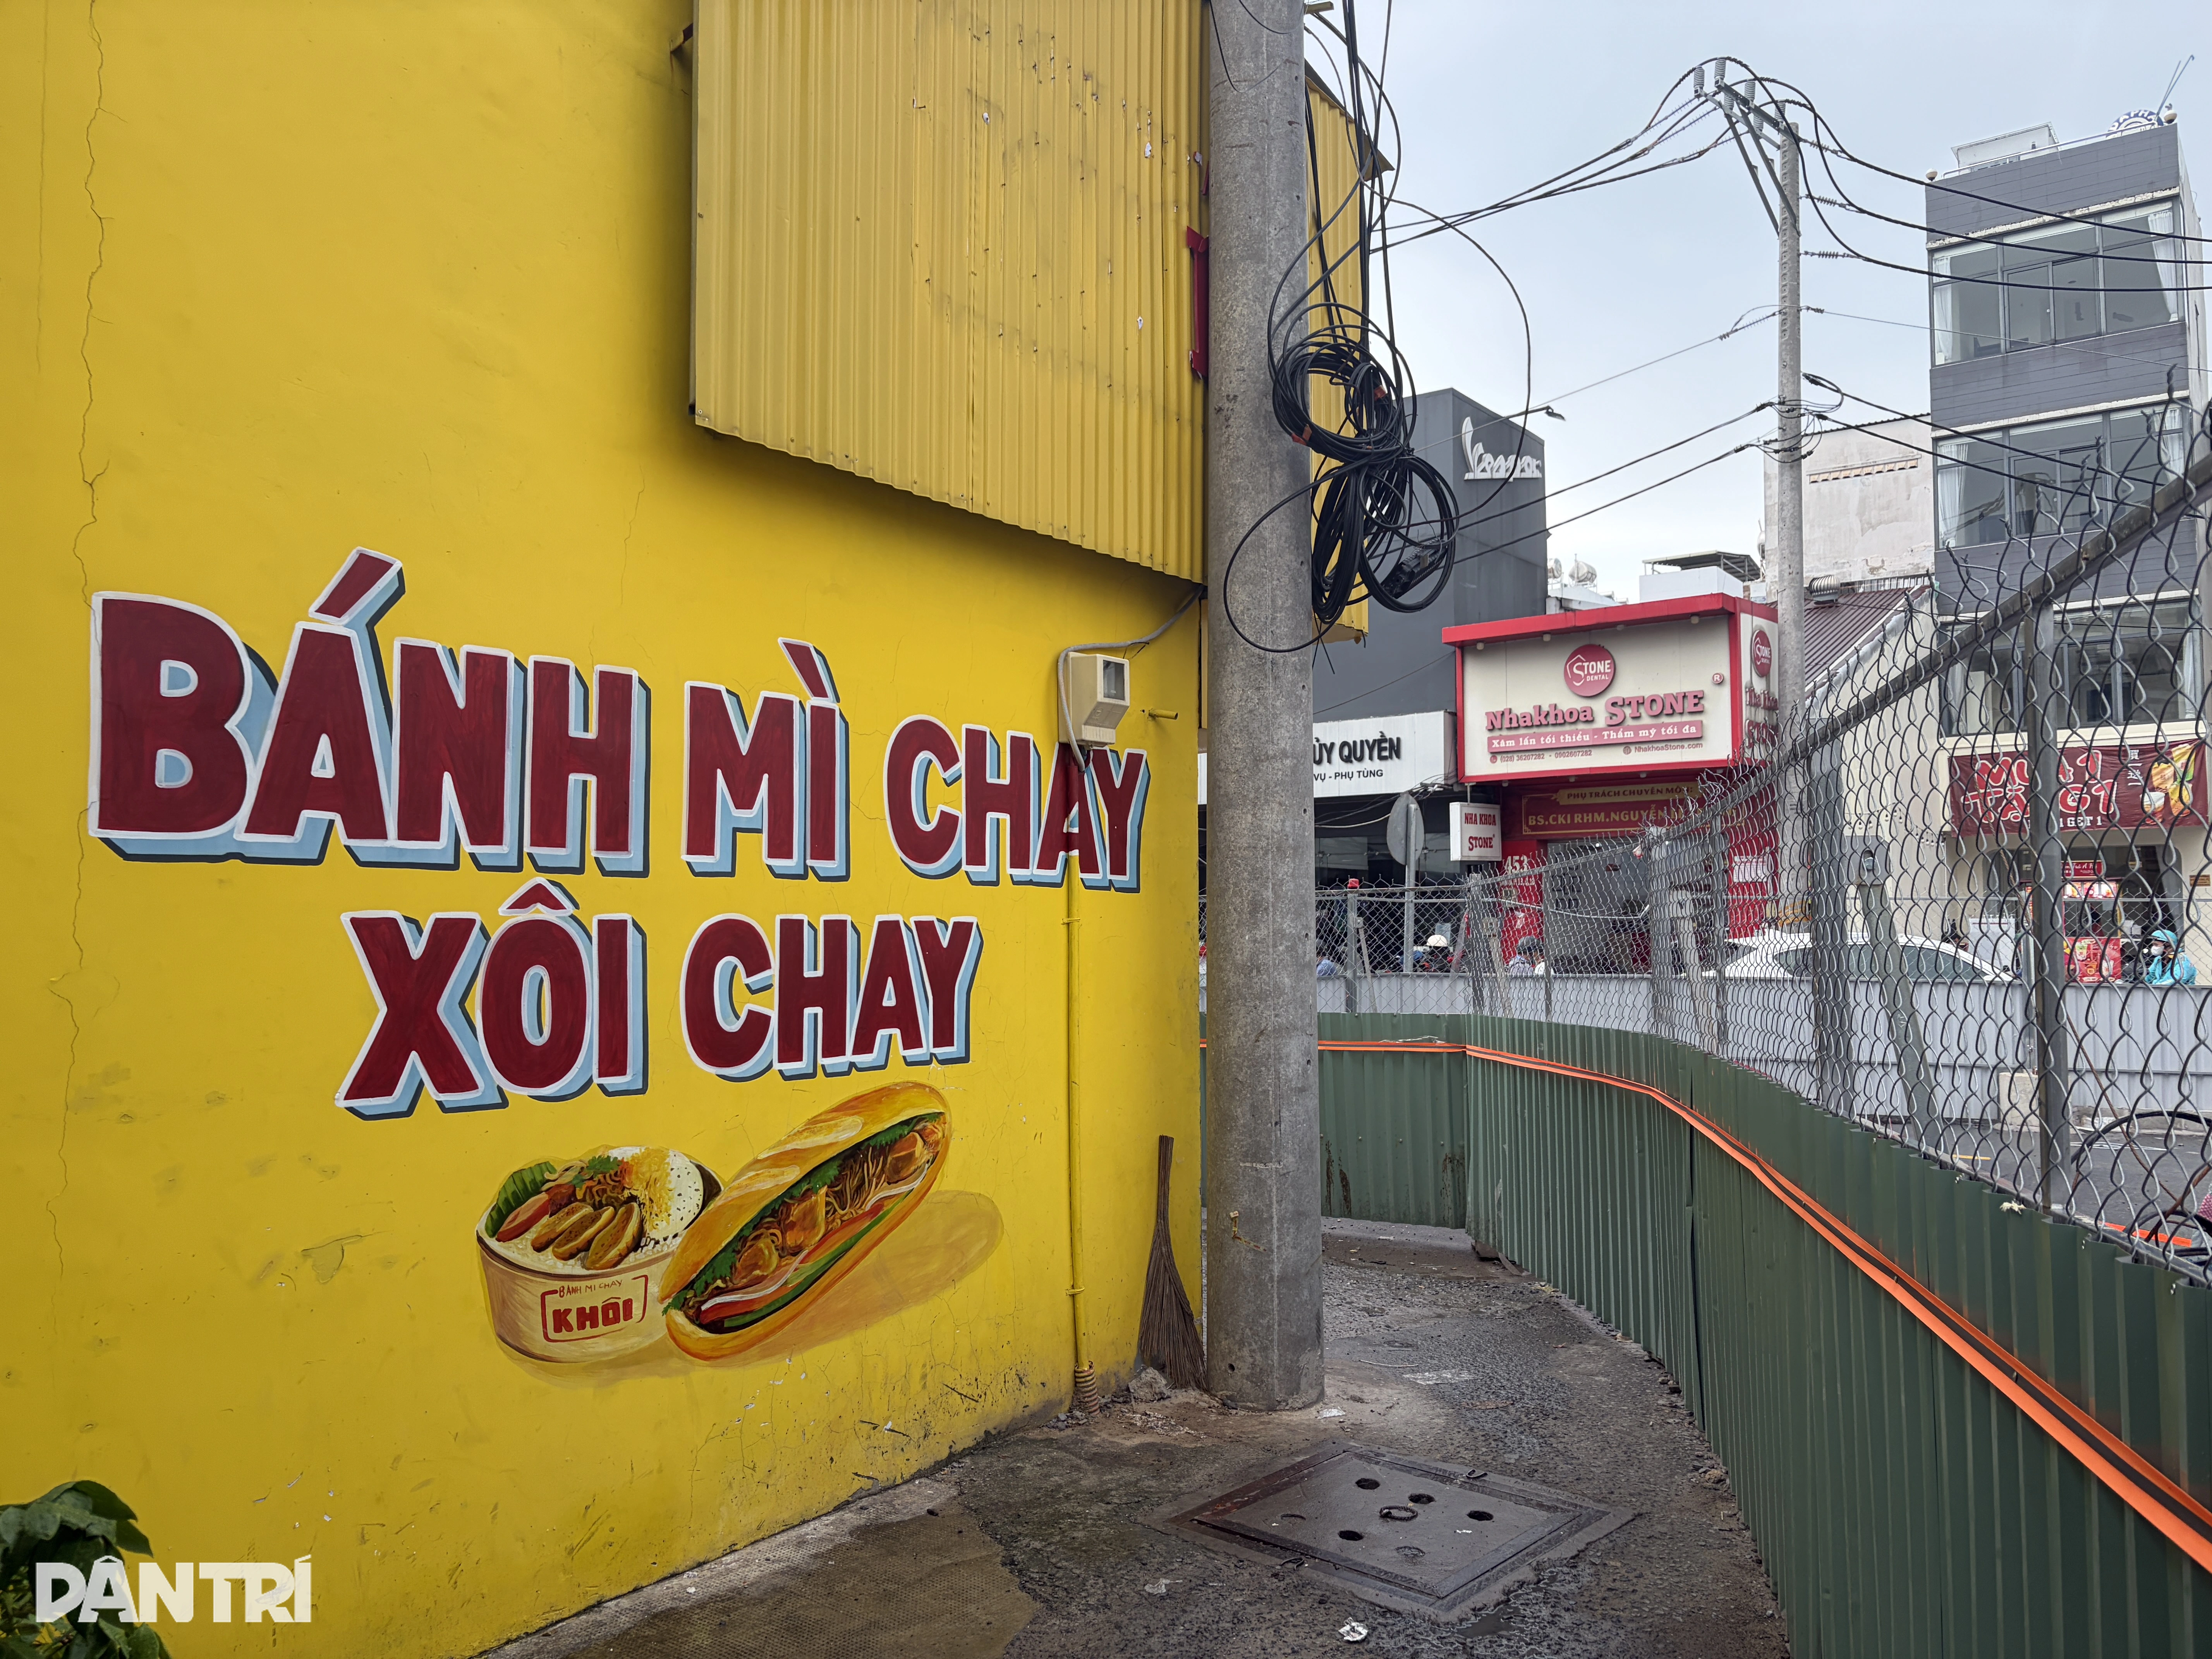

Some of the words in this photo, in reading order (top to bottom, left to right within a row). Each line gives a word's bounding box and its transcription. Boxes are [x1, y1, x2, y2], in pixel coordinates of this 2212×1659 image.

[1573, 660, 1611, 681] STONE
[88, 546, 651, 878] BÁNH
[681, 637, 850, 881] MÌ
[884, 714, 1151, 894] CHAY
[1485, 703, 1594, 730] Nhakhoa
[1605, 690, 1704, 726] STONE
[1519, 735, 1536, 746] lấn
[1540, 734, 1556, 744] tối
[1661, 725, 1678, 735] tối
[1682, 724, 1697, 733] đa
[1339, 731, 1401, 764] QUYỀN
[1334, 771, 1354, 781] PHỤ
[1356, 768, 1384, 779] TÙNG
[1589, 789, 1620, 799] TRÁCH
[1622, 787, 1663, 796] CHUYÊN
[1465, 812, 1478, 825] NHA
[1479, 813, 1496, 826] KHOA
[2067, 816, 2093, 826] GET
[1468, 836, 1493, 851] STONE
[335, 877, 648, 1120] XÔI
[680, 913, 984, 1082] CHAY
[599, 1279, 623, 1289] CHAY
[552, 1297, 633, 1333] KHÔI
